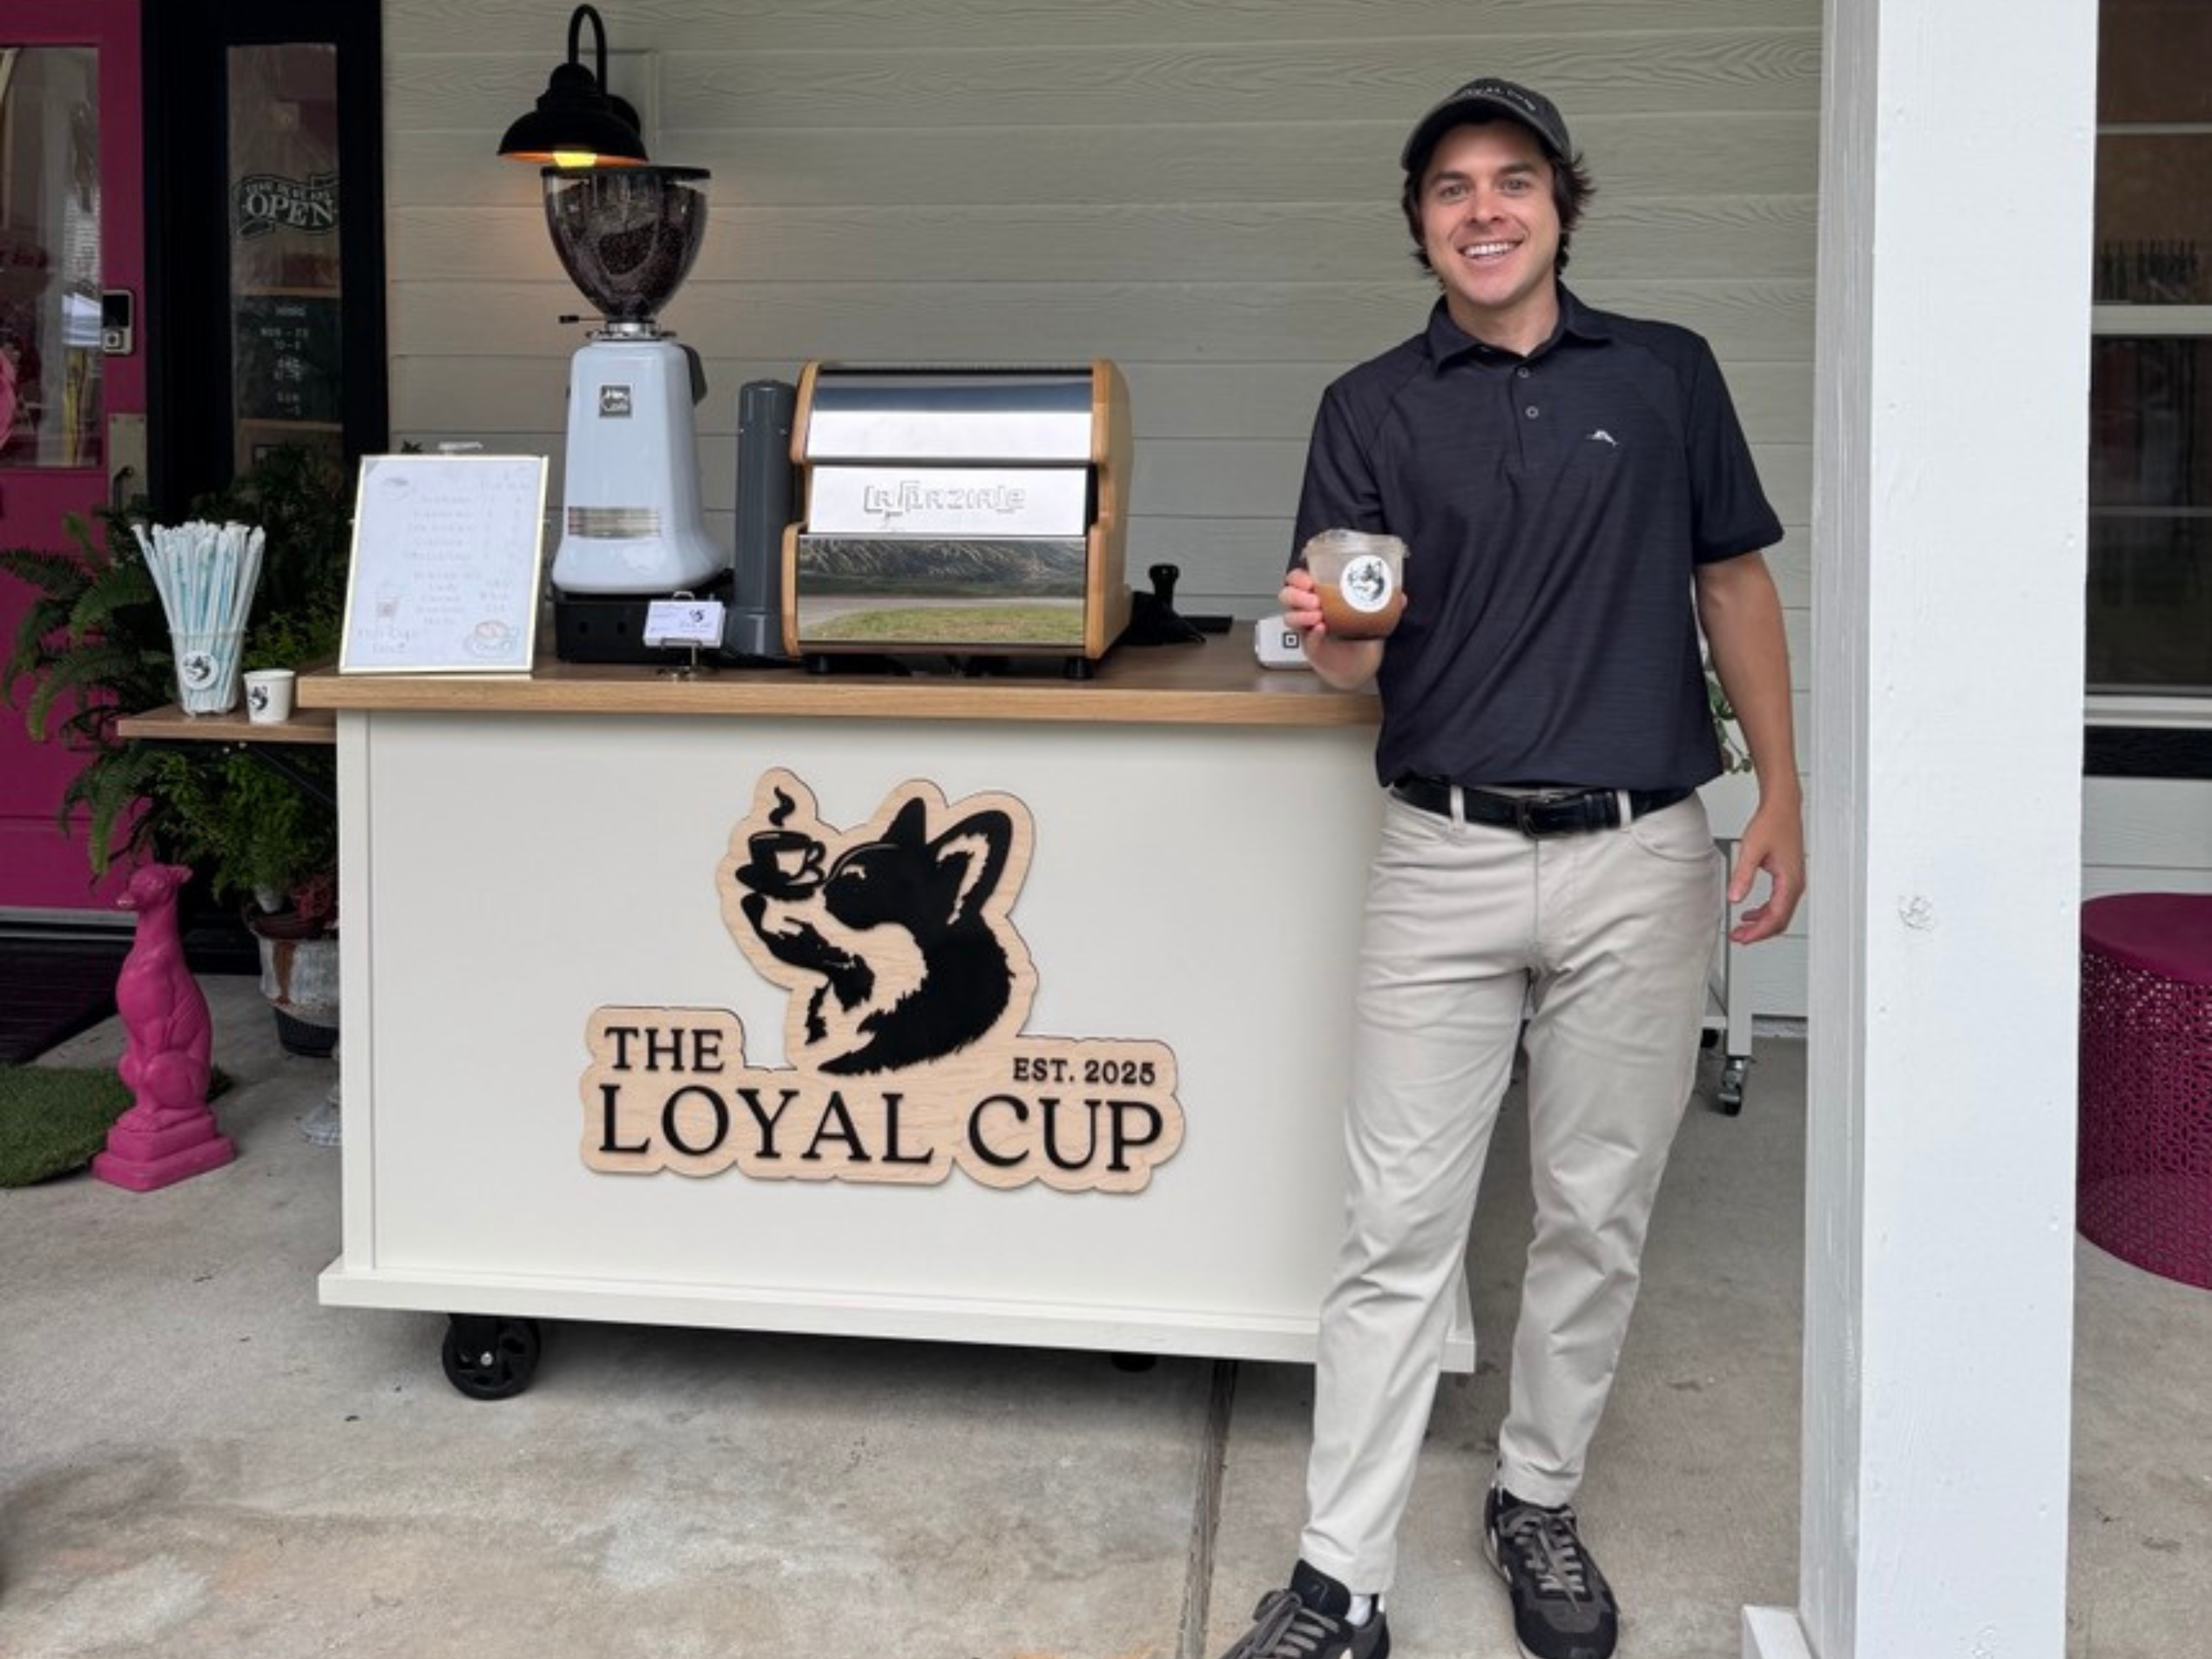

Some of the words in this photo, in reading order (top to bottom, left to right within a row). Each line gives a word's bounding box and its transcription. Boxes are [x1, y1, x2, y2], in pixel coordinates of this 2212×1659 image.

[246, 193, 333, 227] OPEN
[604, 1026, 724, 1073] THE
[1013, 1057, 1075, 1082] EST.
[1084, 1060, 1156, 1086] 2025
[599, 1084, 934, 1165] LOYAL
[968, 1095, 1164, 1172] CUP
